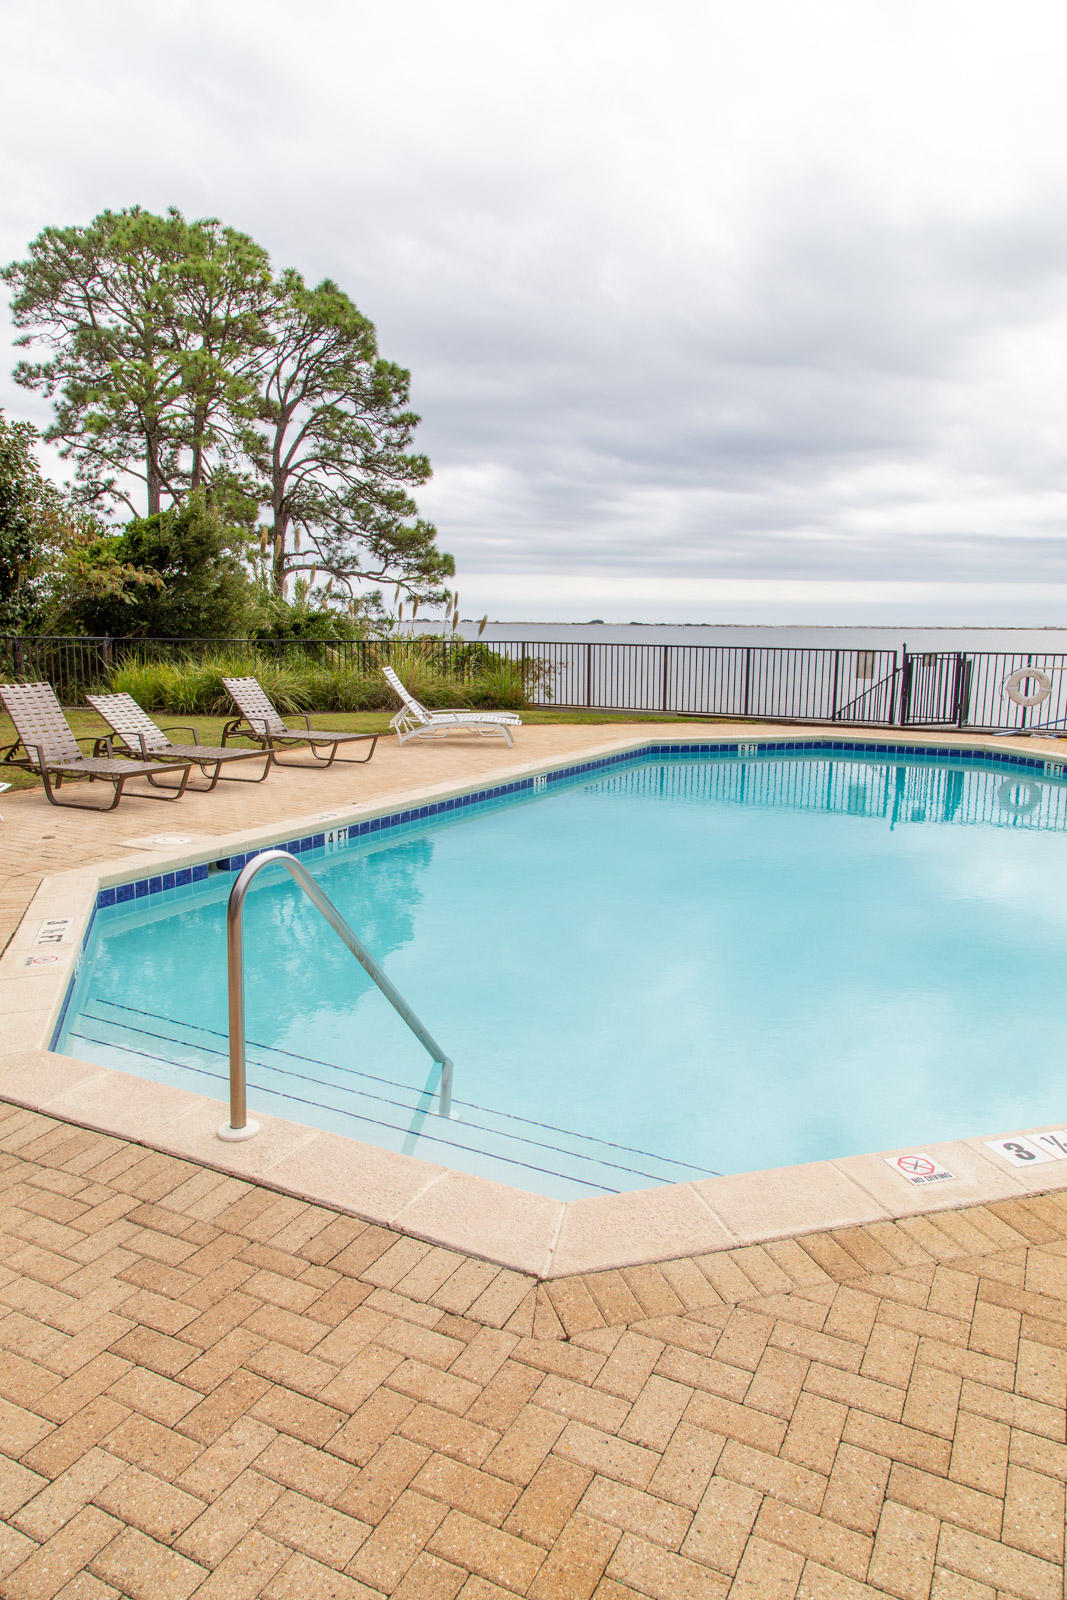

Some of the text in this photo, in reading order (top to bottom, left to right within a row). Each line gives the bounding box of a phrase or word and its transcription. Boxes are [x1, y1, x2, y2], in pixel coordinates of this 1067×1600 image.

[1054, 763, 1063, 771] FT
[328, 828, 348, 843] 4 FT
[38, 934, 63, 945] FT
[1002, 1142, 1036, 1161] 3
[910, 1171, 953, 1184] NO DIVING
